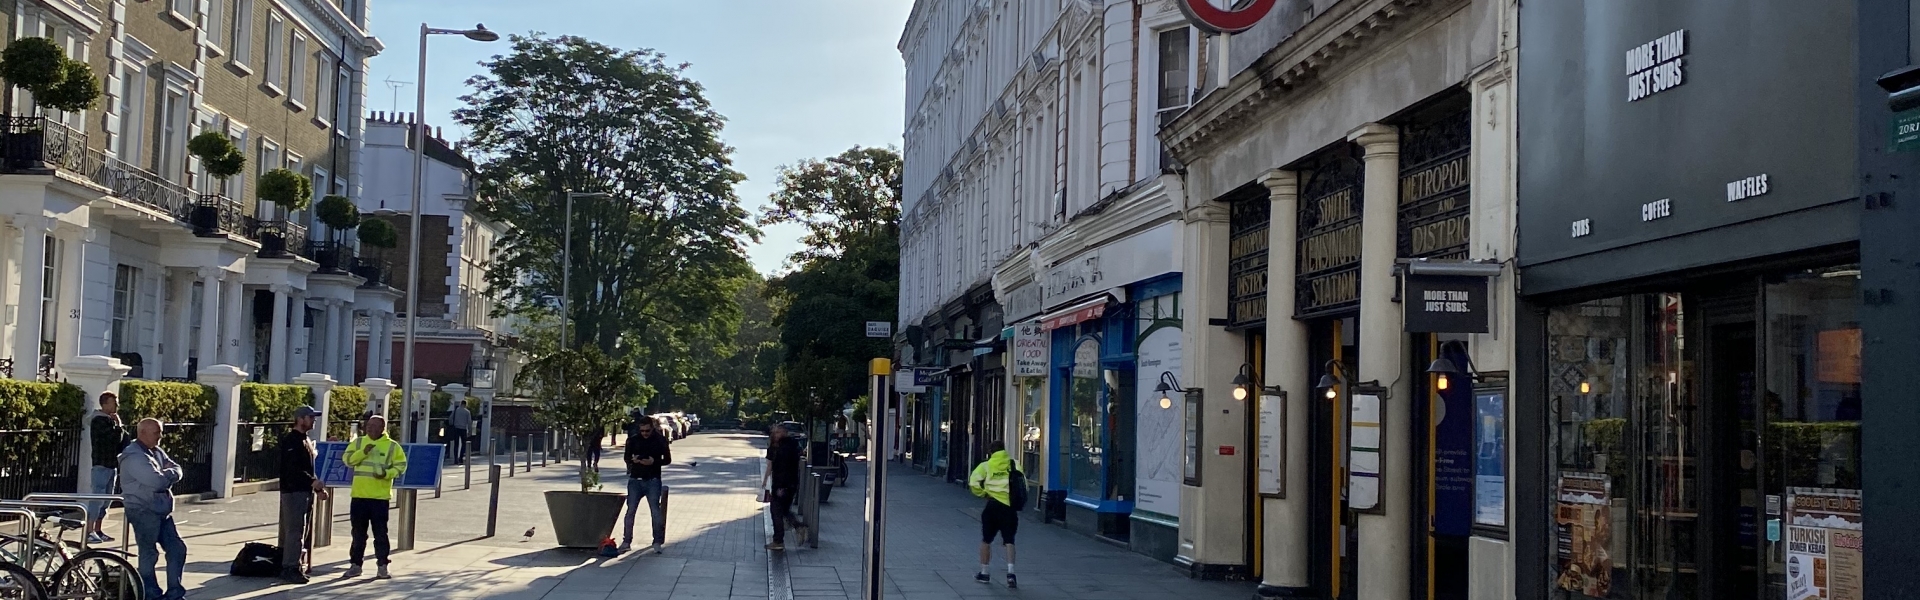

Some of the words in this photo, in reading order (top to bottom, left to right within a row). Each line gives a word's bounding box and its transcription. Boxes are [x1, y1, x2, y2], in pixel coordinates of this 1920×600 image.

[1626, 40, 1655, 76] MORE
[1655, 28, 1684, 64] THAN
[1627, 69, 1652, 102] JUST
[1652, 58, 1682, 93] SUBS
[1727, 173, 1767, 202] WAFFLES
[1319, 188, 1351, 225] SOUTH
[1438, 197, 1455, 212] AND
[1642, 198, 1670, 222] COFFEE
[1572, 218, 1590, 238] SUBS
[1312, 270, 1356, 307] STATION
[1424, 291, 1447, 302] MORE
[1447, 291, 1469, 302] THAN
[1425, 302, 1444, 312] JUST
[1445, 302, 1470, 312] SUBS.
[1016, 338, 1047, 348] ORIENTAL
[1022, 349, 1041, 358] FOOD
[1796, 496, 1824, 508] COOLEST
[1790, 527, 1826, 545] TURKISH
[1789, 541, 1807, 552] DONER
[1808, 543, 1826, 555] KEBAB
